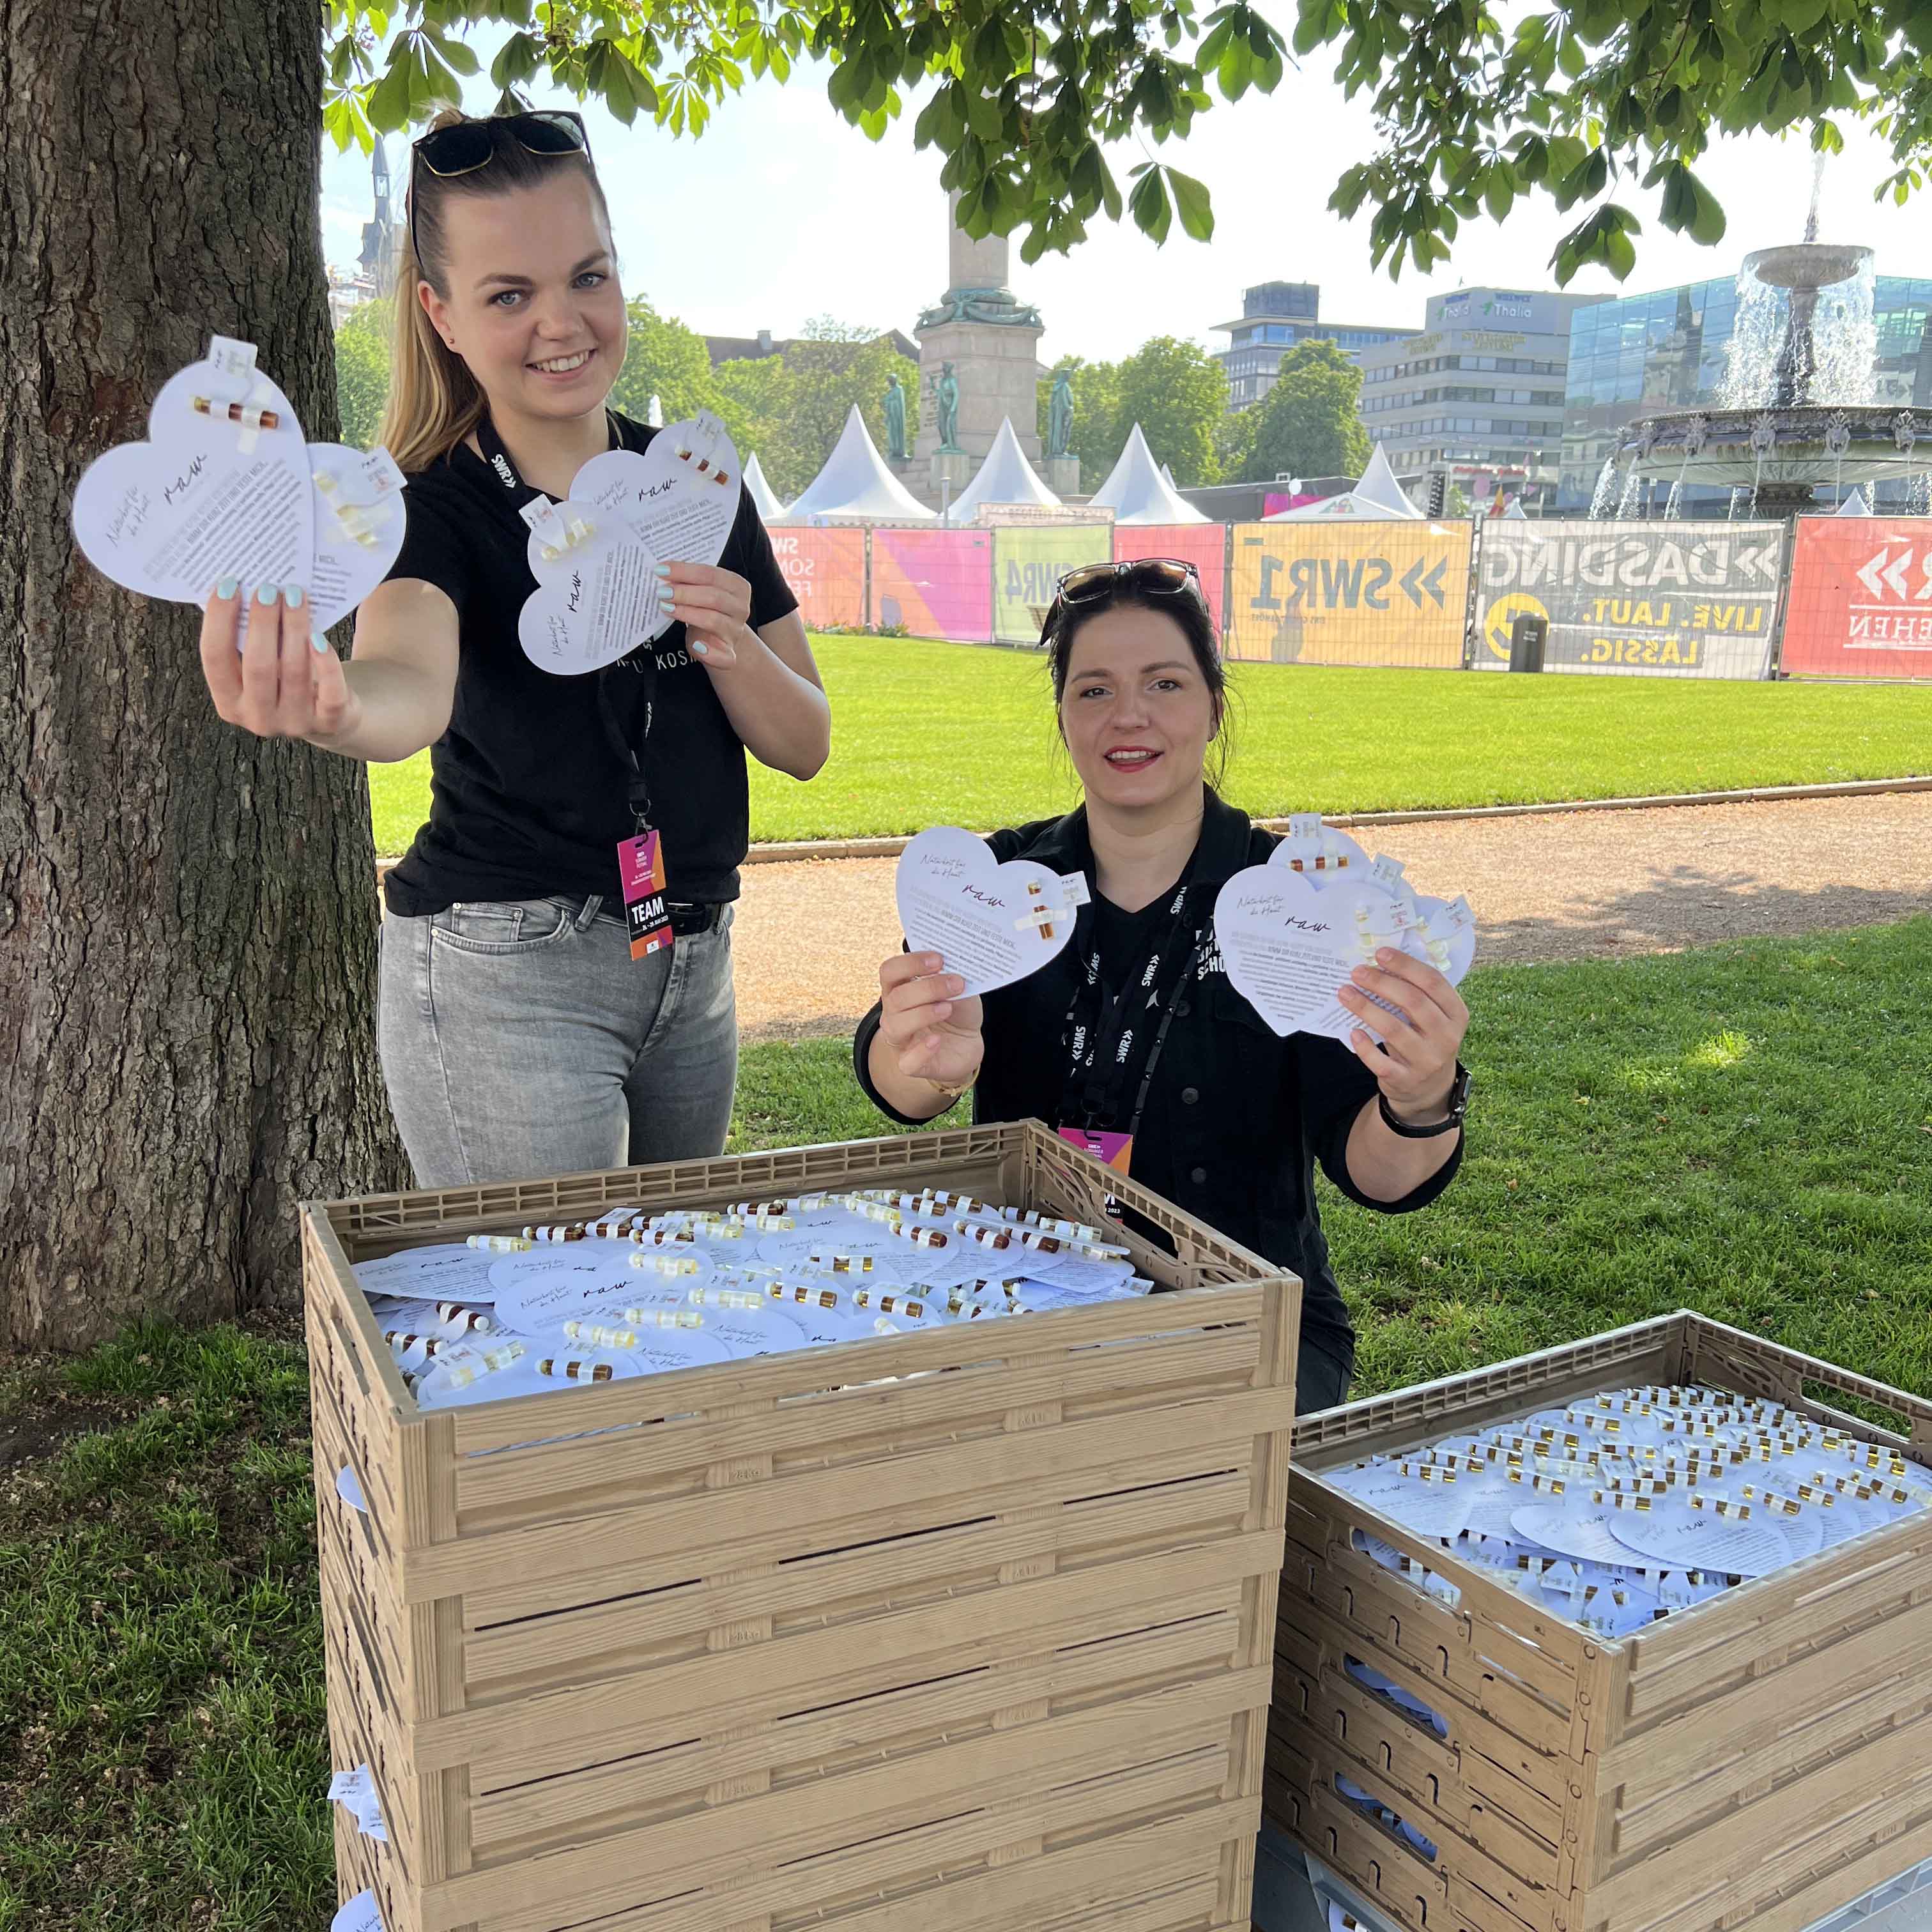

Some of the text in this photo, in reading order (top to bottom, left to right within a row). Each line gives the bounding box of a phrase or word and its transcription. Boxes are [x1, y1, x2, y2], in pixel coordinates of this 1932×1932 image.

[1494, 303, 1532, 318] Thalia
[491, 454, 512, 480] SWR
[164, 454, 208, 505] raw
[639, 477, 677, 502] raw
[567, 569, 581, 613] raw
[962, 884, 1006, 907] raw
[631, 896, 664, 924] TEAM
[1284, 916, 1331, 932] raw
[1141, 964, 1158, 987] SWR
[1073, 1025, 1087, 1050] SWR
[1116, 1039, 1130, 1064] SWR
[583, 1280, 634, 1298] raw
[1367, 1484, 1406, 1496] raw
[1676, 1519, 1708, 1535] raw
